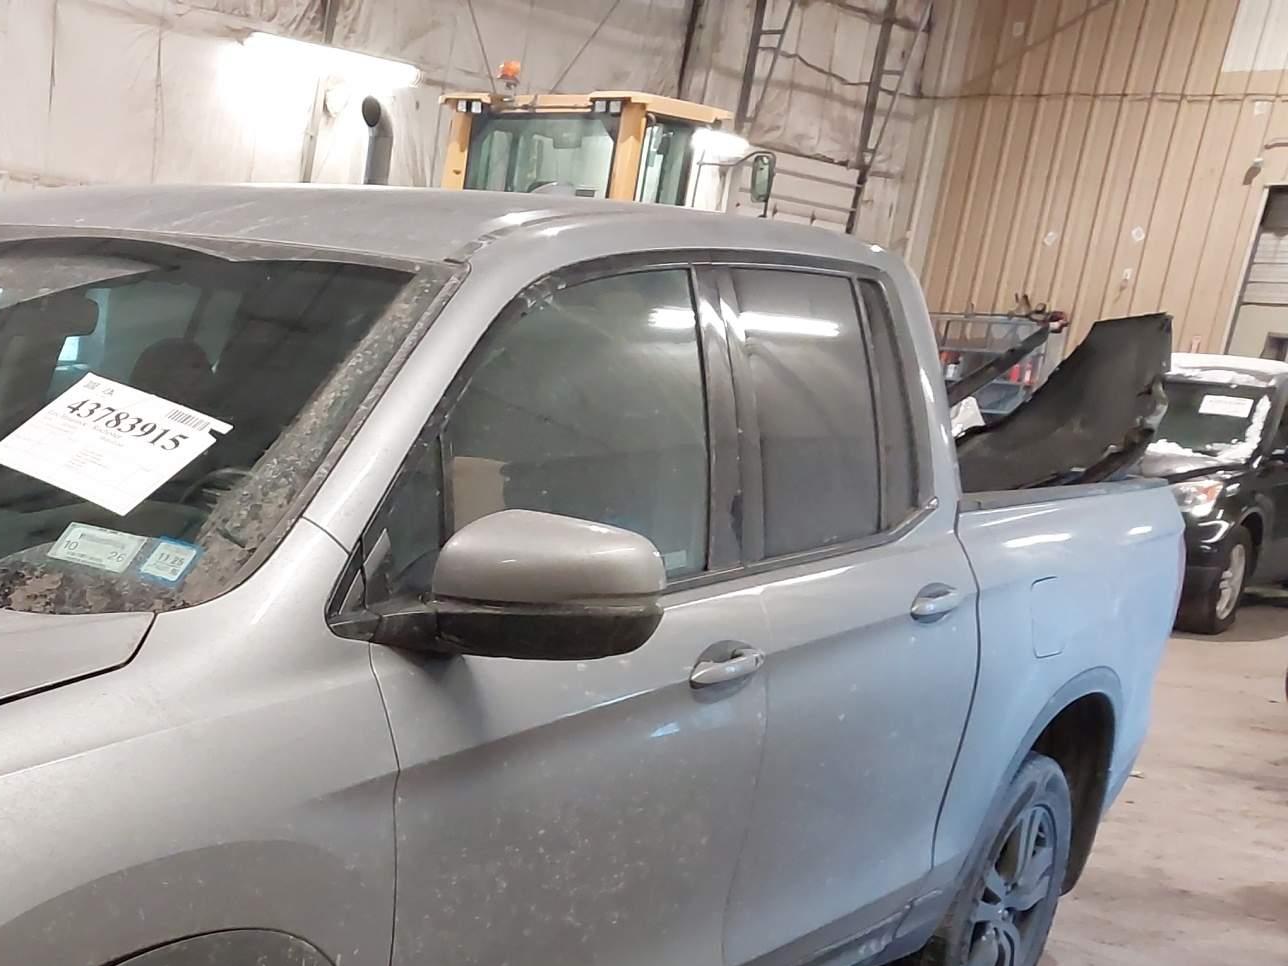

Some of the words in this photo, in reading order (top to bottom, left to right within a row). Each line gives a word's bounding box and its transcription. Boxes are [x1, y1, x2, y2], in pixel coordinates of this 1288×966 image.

[66, 398, 189, 452] 43783915
[63, 540, 79, 551] 10
[107, 551, 127, 563] 26
